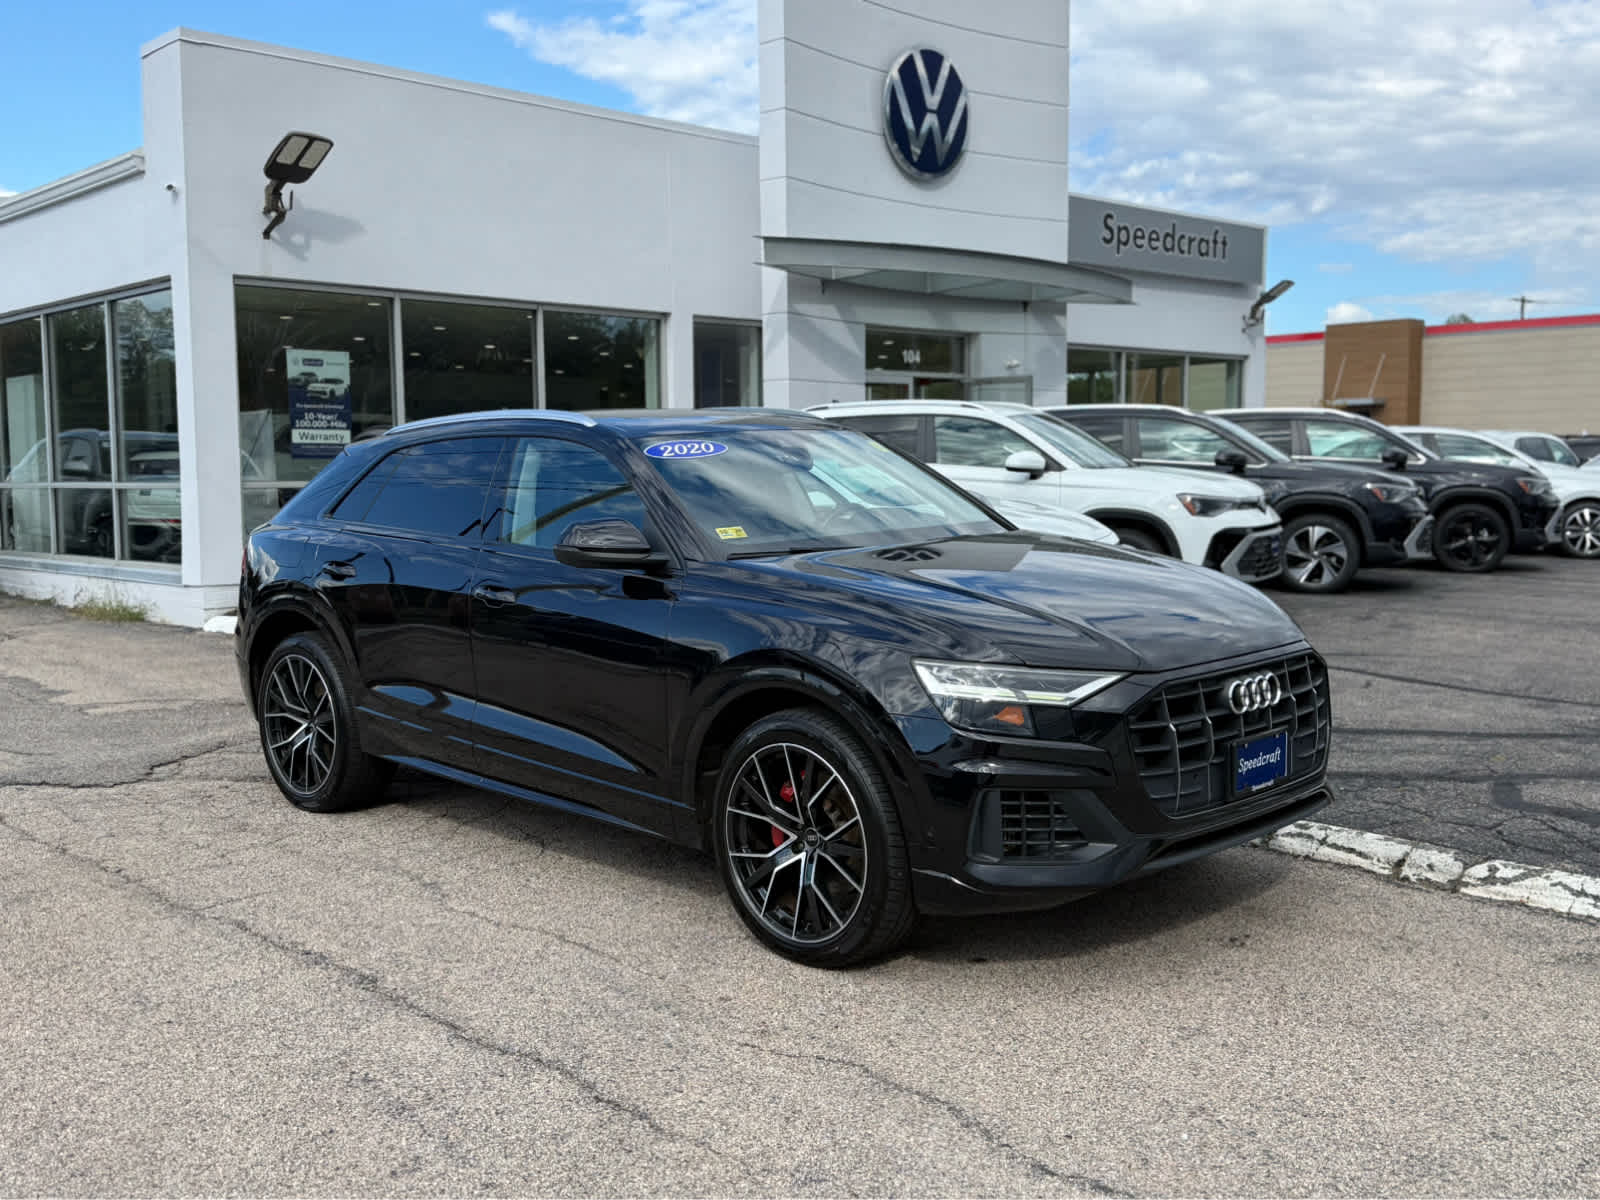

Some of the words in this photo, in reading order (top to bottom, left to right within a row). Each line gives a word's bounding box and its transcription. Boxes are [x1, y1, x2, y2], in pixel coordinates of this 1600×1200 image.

[887, 49, 967, 170] VW
[1102, 213, 1228, 260] Speedcraft
[902, 349, 921, 364] 104
[299, 432, 344, 443] Warranty
[660, 442, 714, 457] 2020
[1238, 747, 1281, 775] Speedcraft
